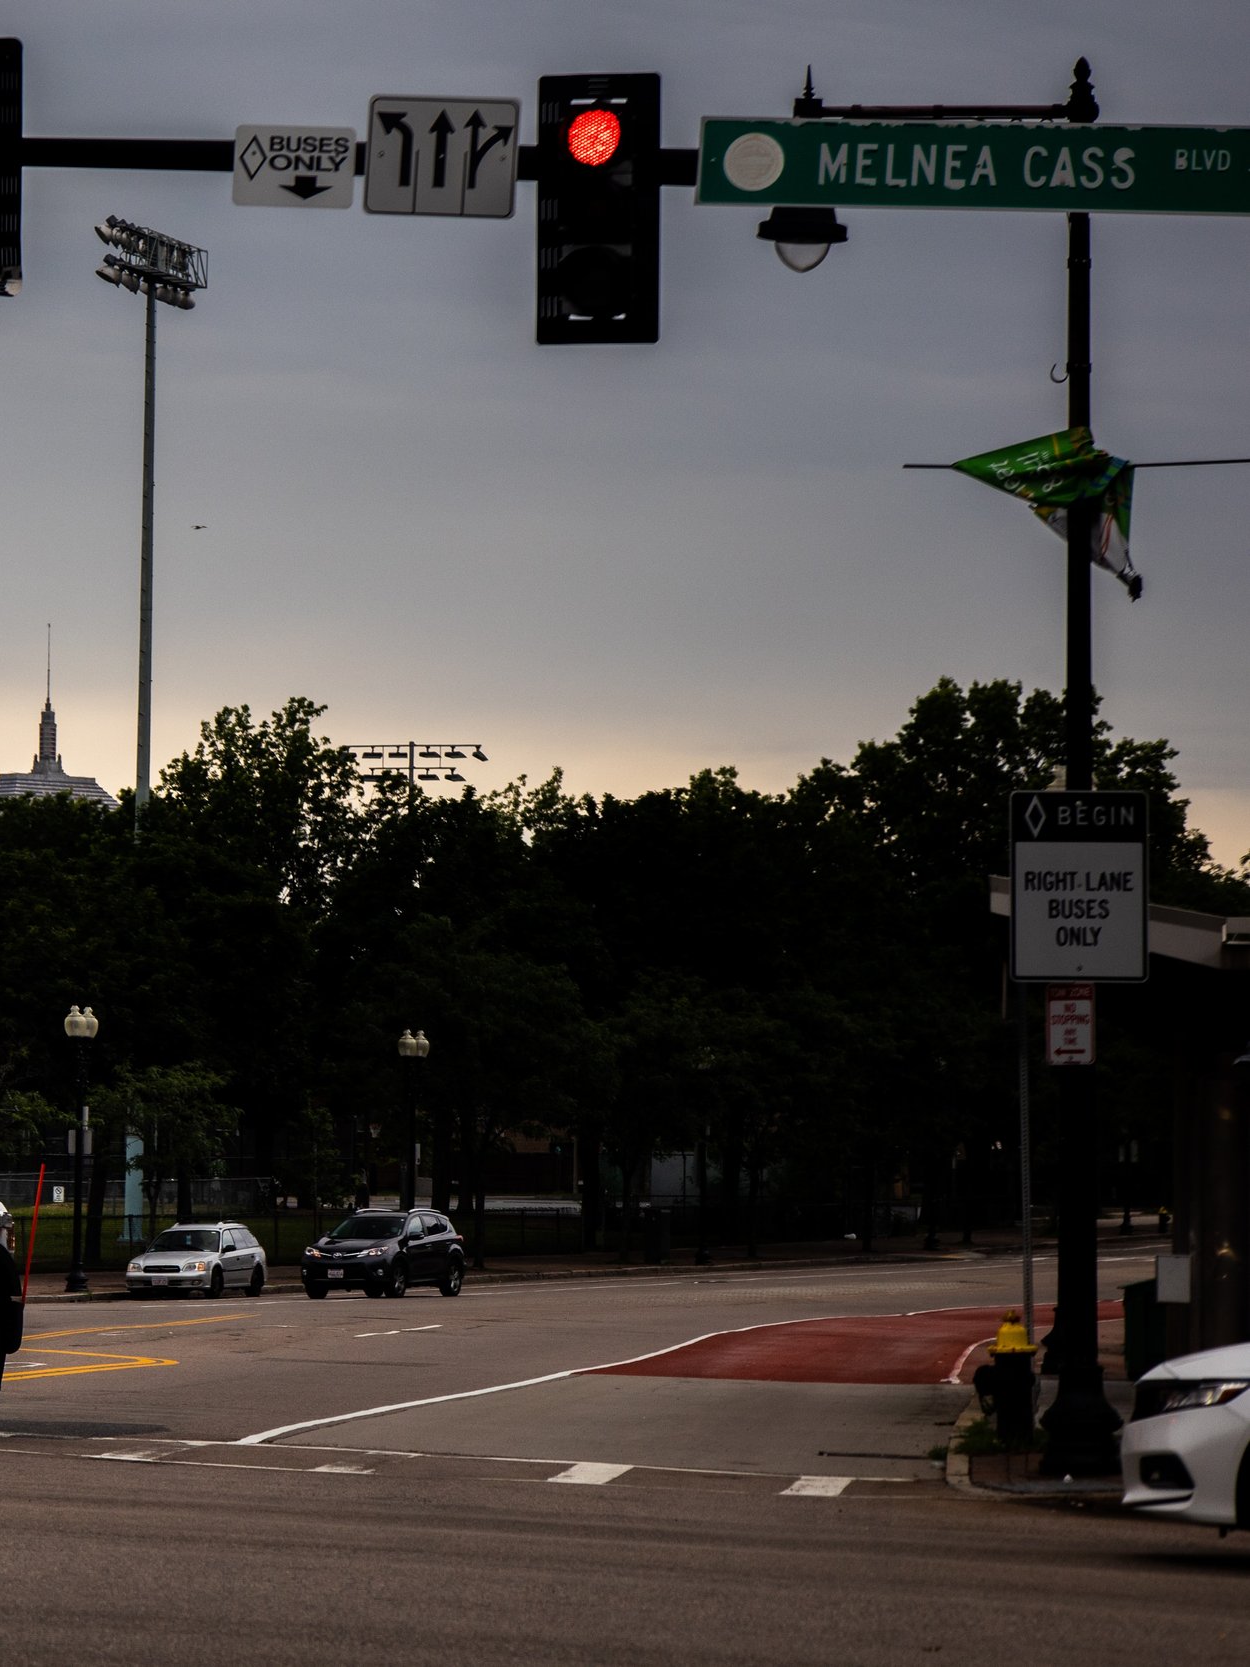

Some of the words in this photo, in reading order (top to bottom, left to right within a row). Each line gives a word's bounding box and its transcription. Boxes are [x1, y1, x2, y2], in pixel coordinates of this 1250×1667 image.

[268, 135, 350, 154] BUSES
[268, 154, 348, 173] ONLY
[816, 143, 997, 190] MELNEA
[1023, 145, 1136, 190] CASS
[1174, 148, 1231, 172] BLVD
[1057, 805, 1135, 825] BEGIN
[1024, 870, 1078, 892] RIGHT
[1085, 871, 1134, 892] LANE
[1048, 898, 1110, 919] BUSES
[1055, 926, 1102, 947] ONLY
